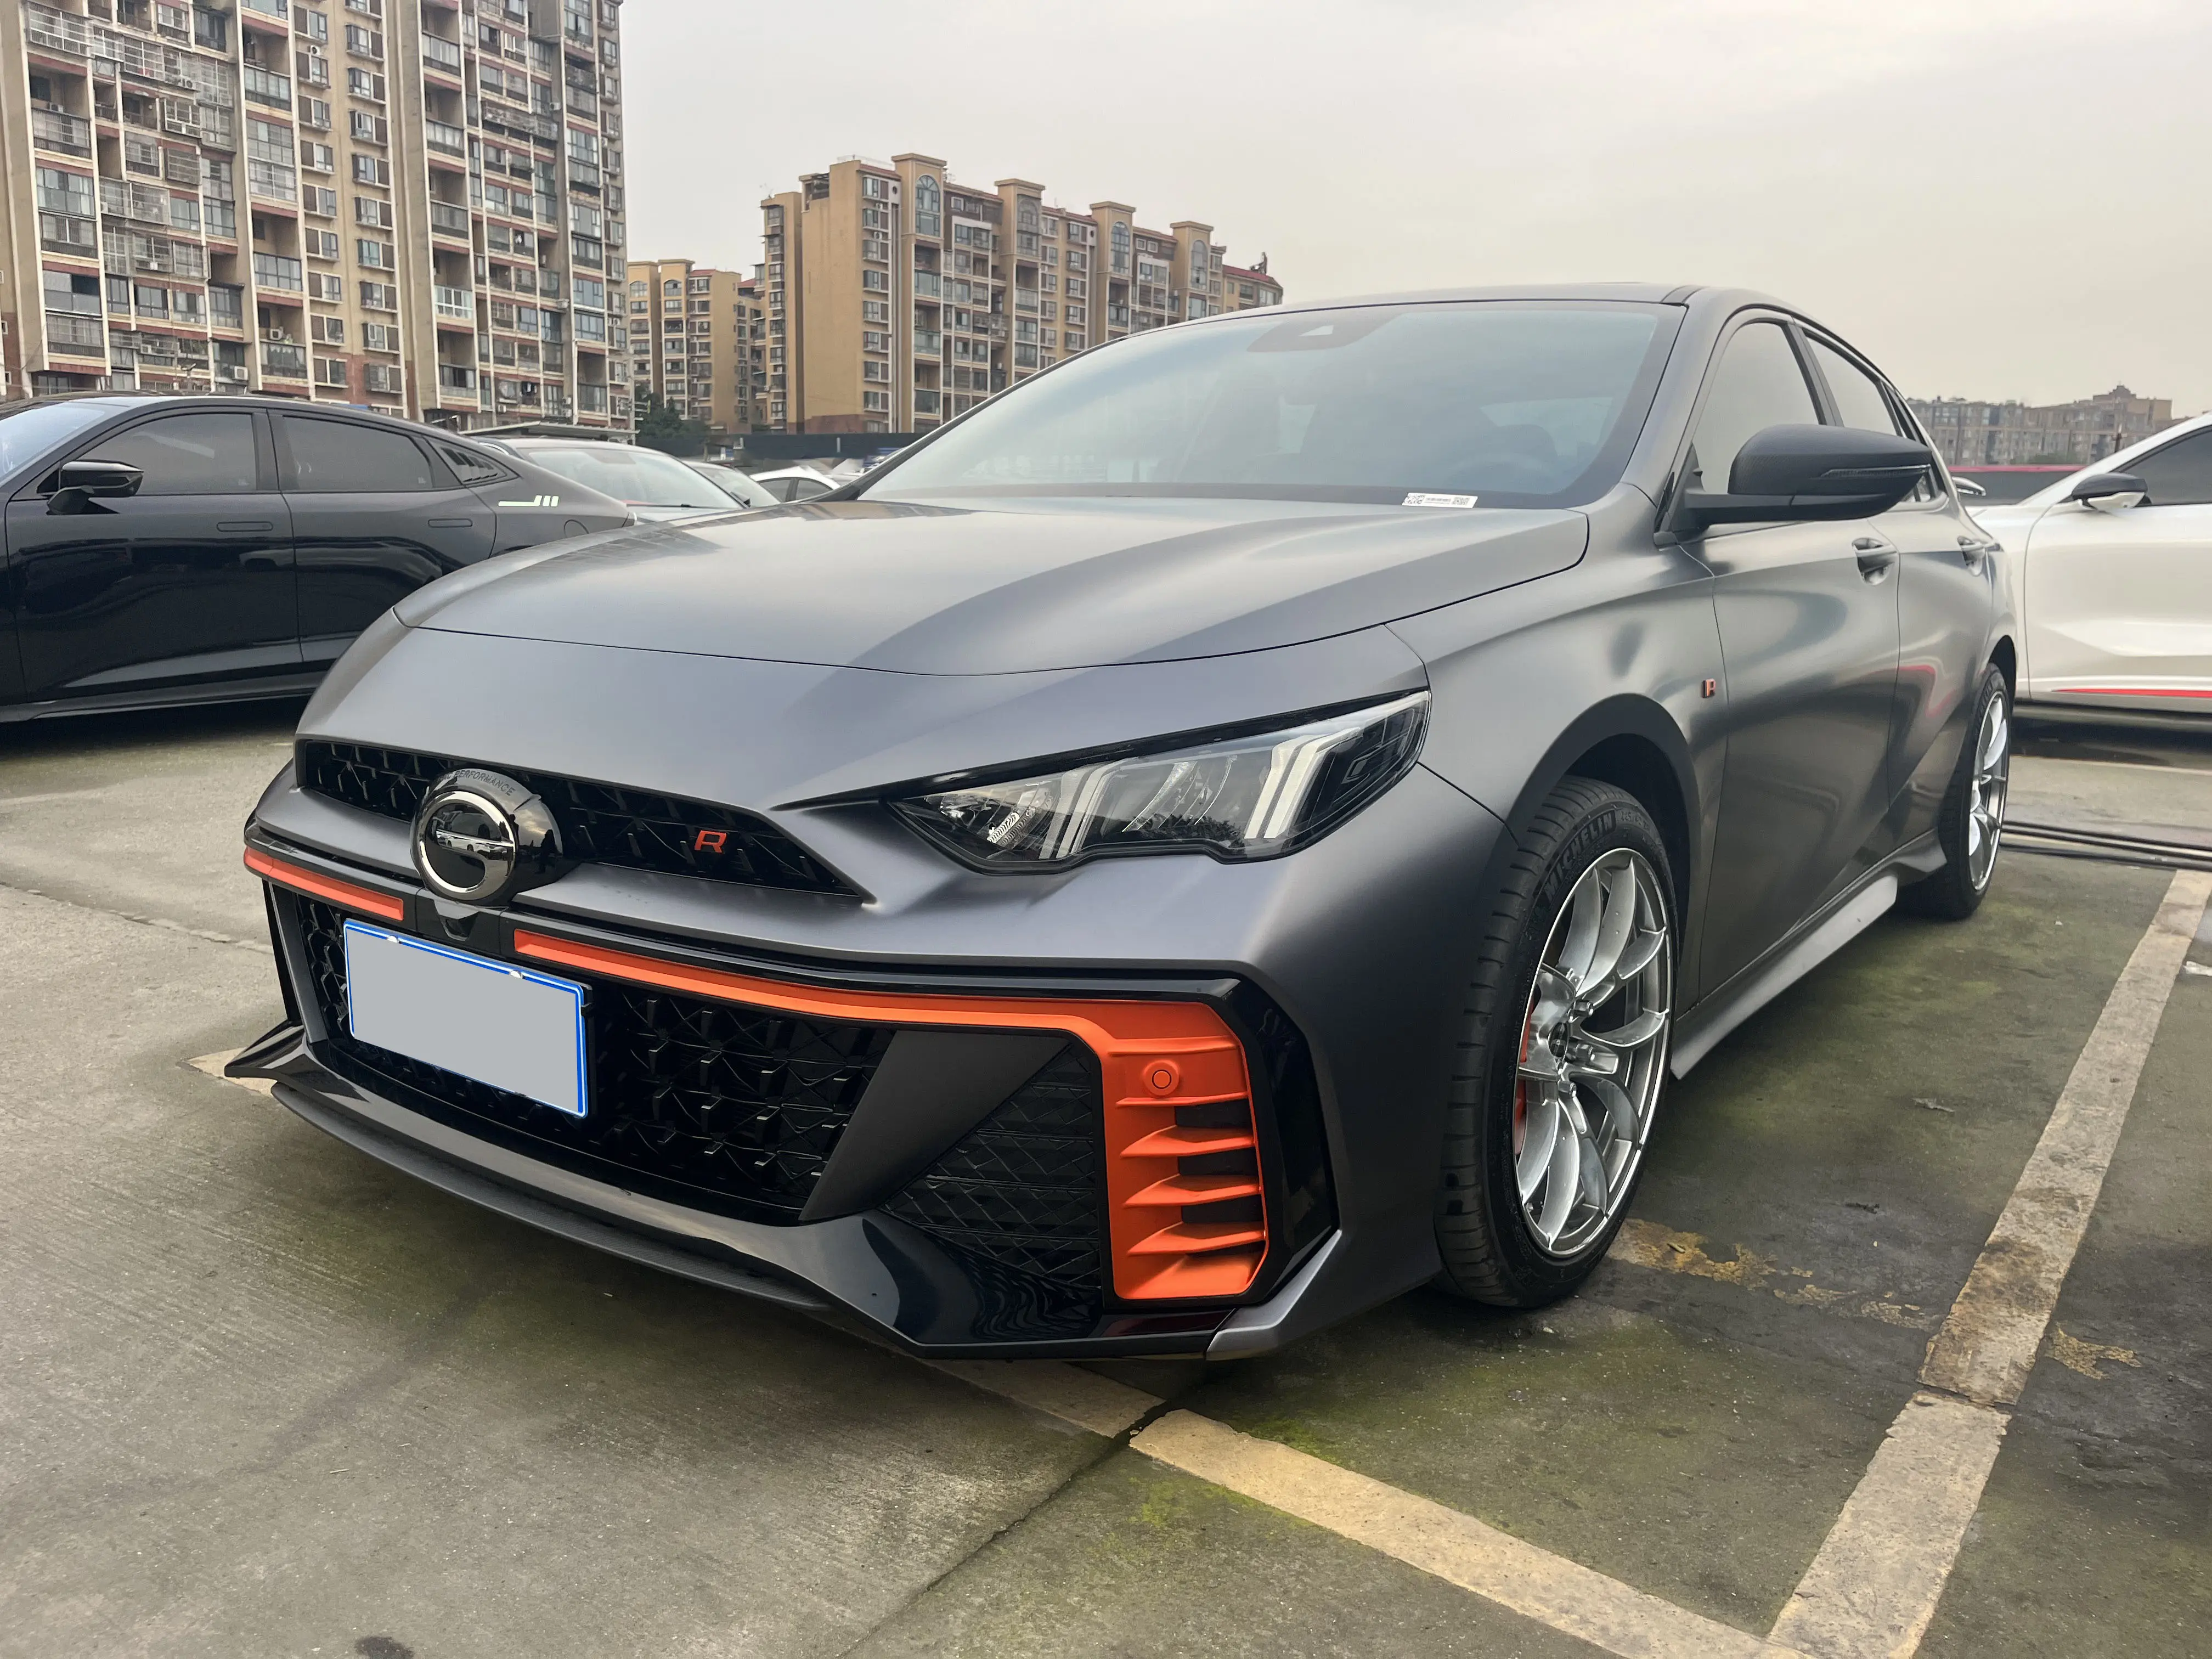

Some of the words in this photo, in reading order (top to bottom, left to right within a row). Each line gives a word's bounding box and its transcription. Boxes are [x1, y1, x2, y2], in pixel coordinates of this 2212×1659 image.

[454, 770, 516, 796] PERFORMANCE
[694, 830, 727, 854] R
[1543, 812, 1613, 902] MICHELIN
